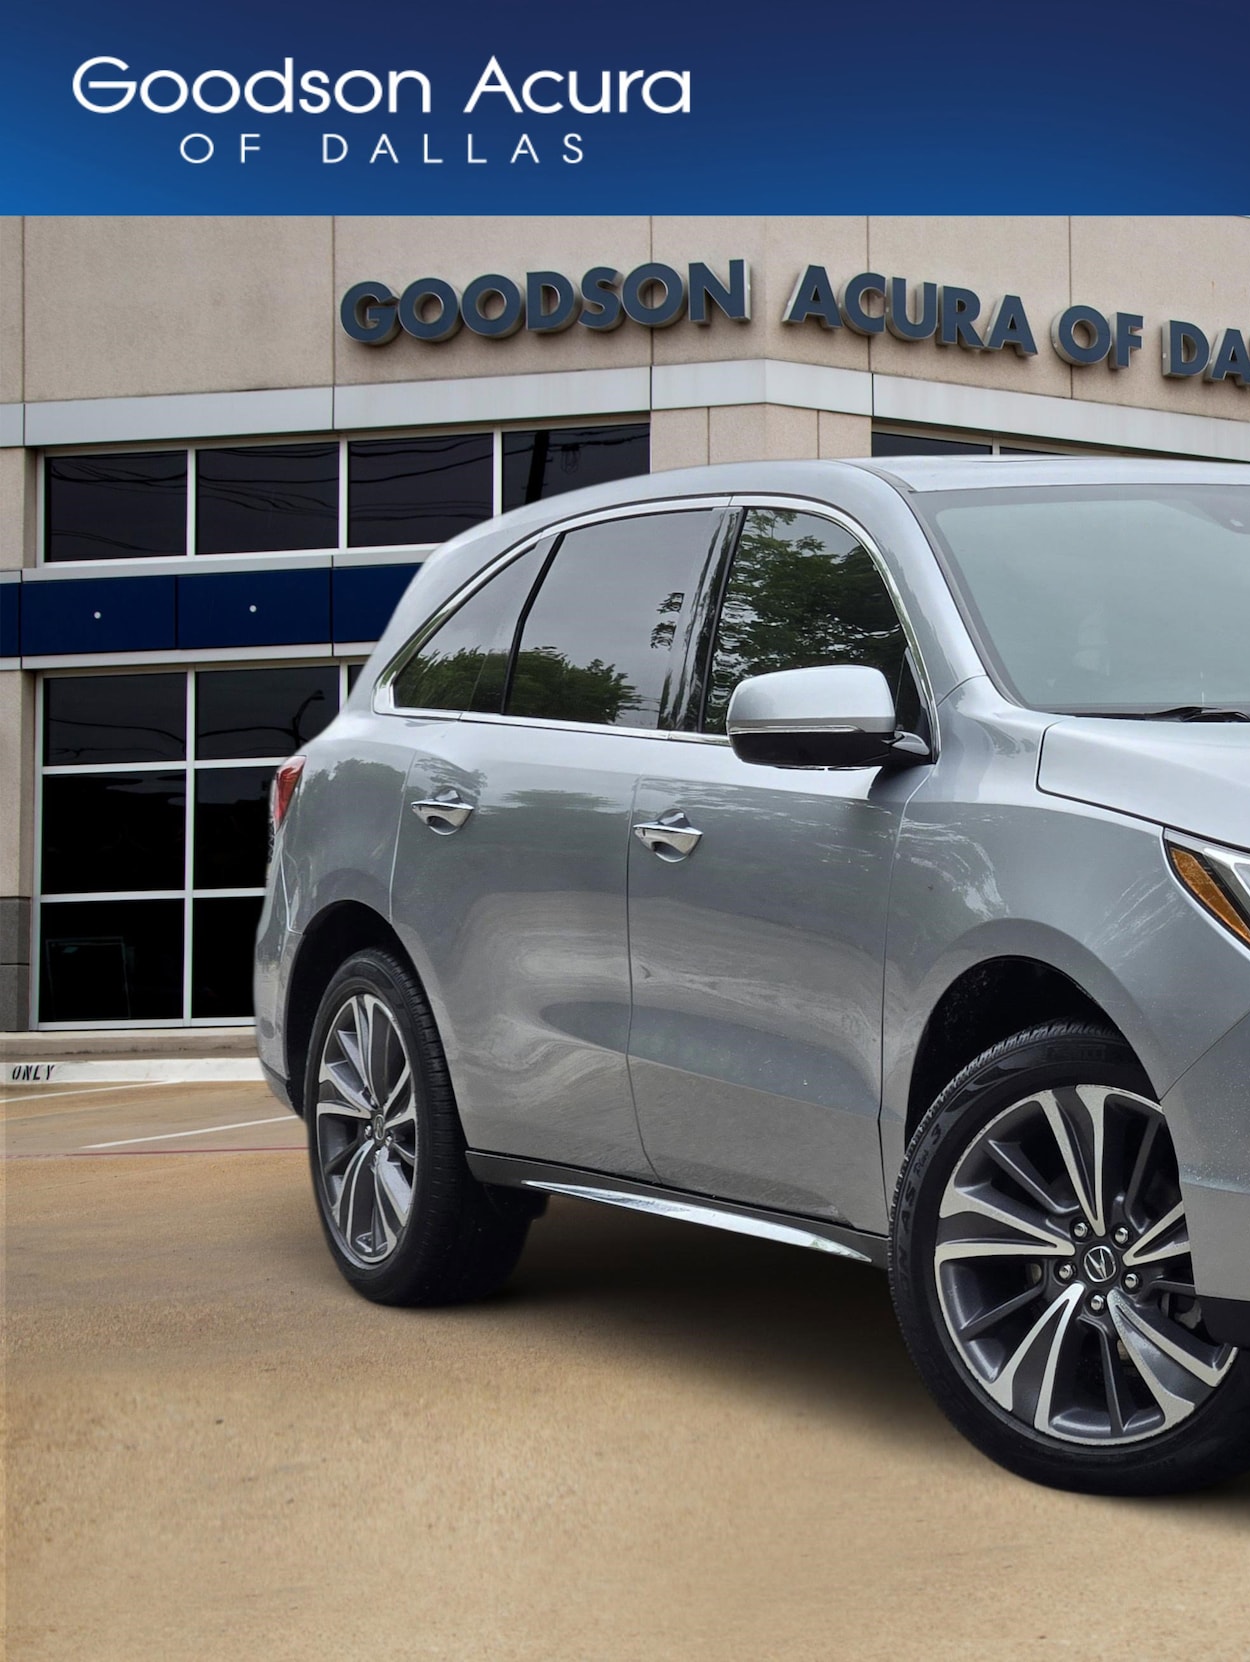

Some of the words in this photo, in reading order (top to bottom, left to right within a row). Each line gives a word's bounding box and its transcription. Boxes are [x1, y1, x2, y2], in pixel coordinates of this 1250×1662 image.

[341, 259, 750, 347] GOODSON
[784, 264, 1039, 356] ACURA
[1052, 304, 1144, 370] OF
[11, 1064, 56, 1081] ONLY
